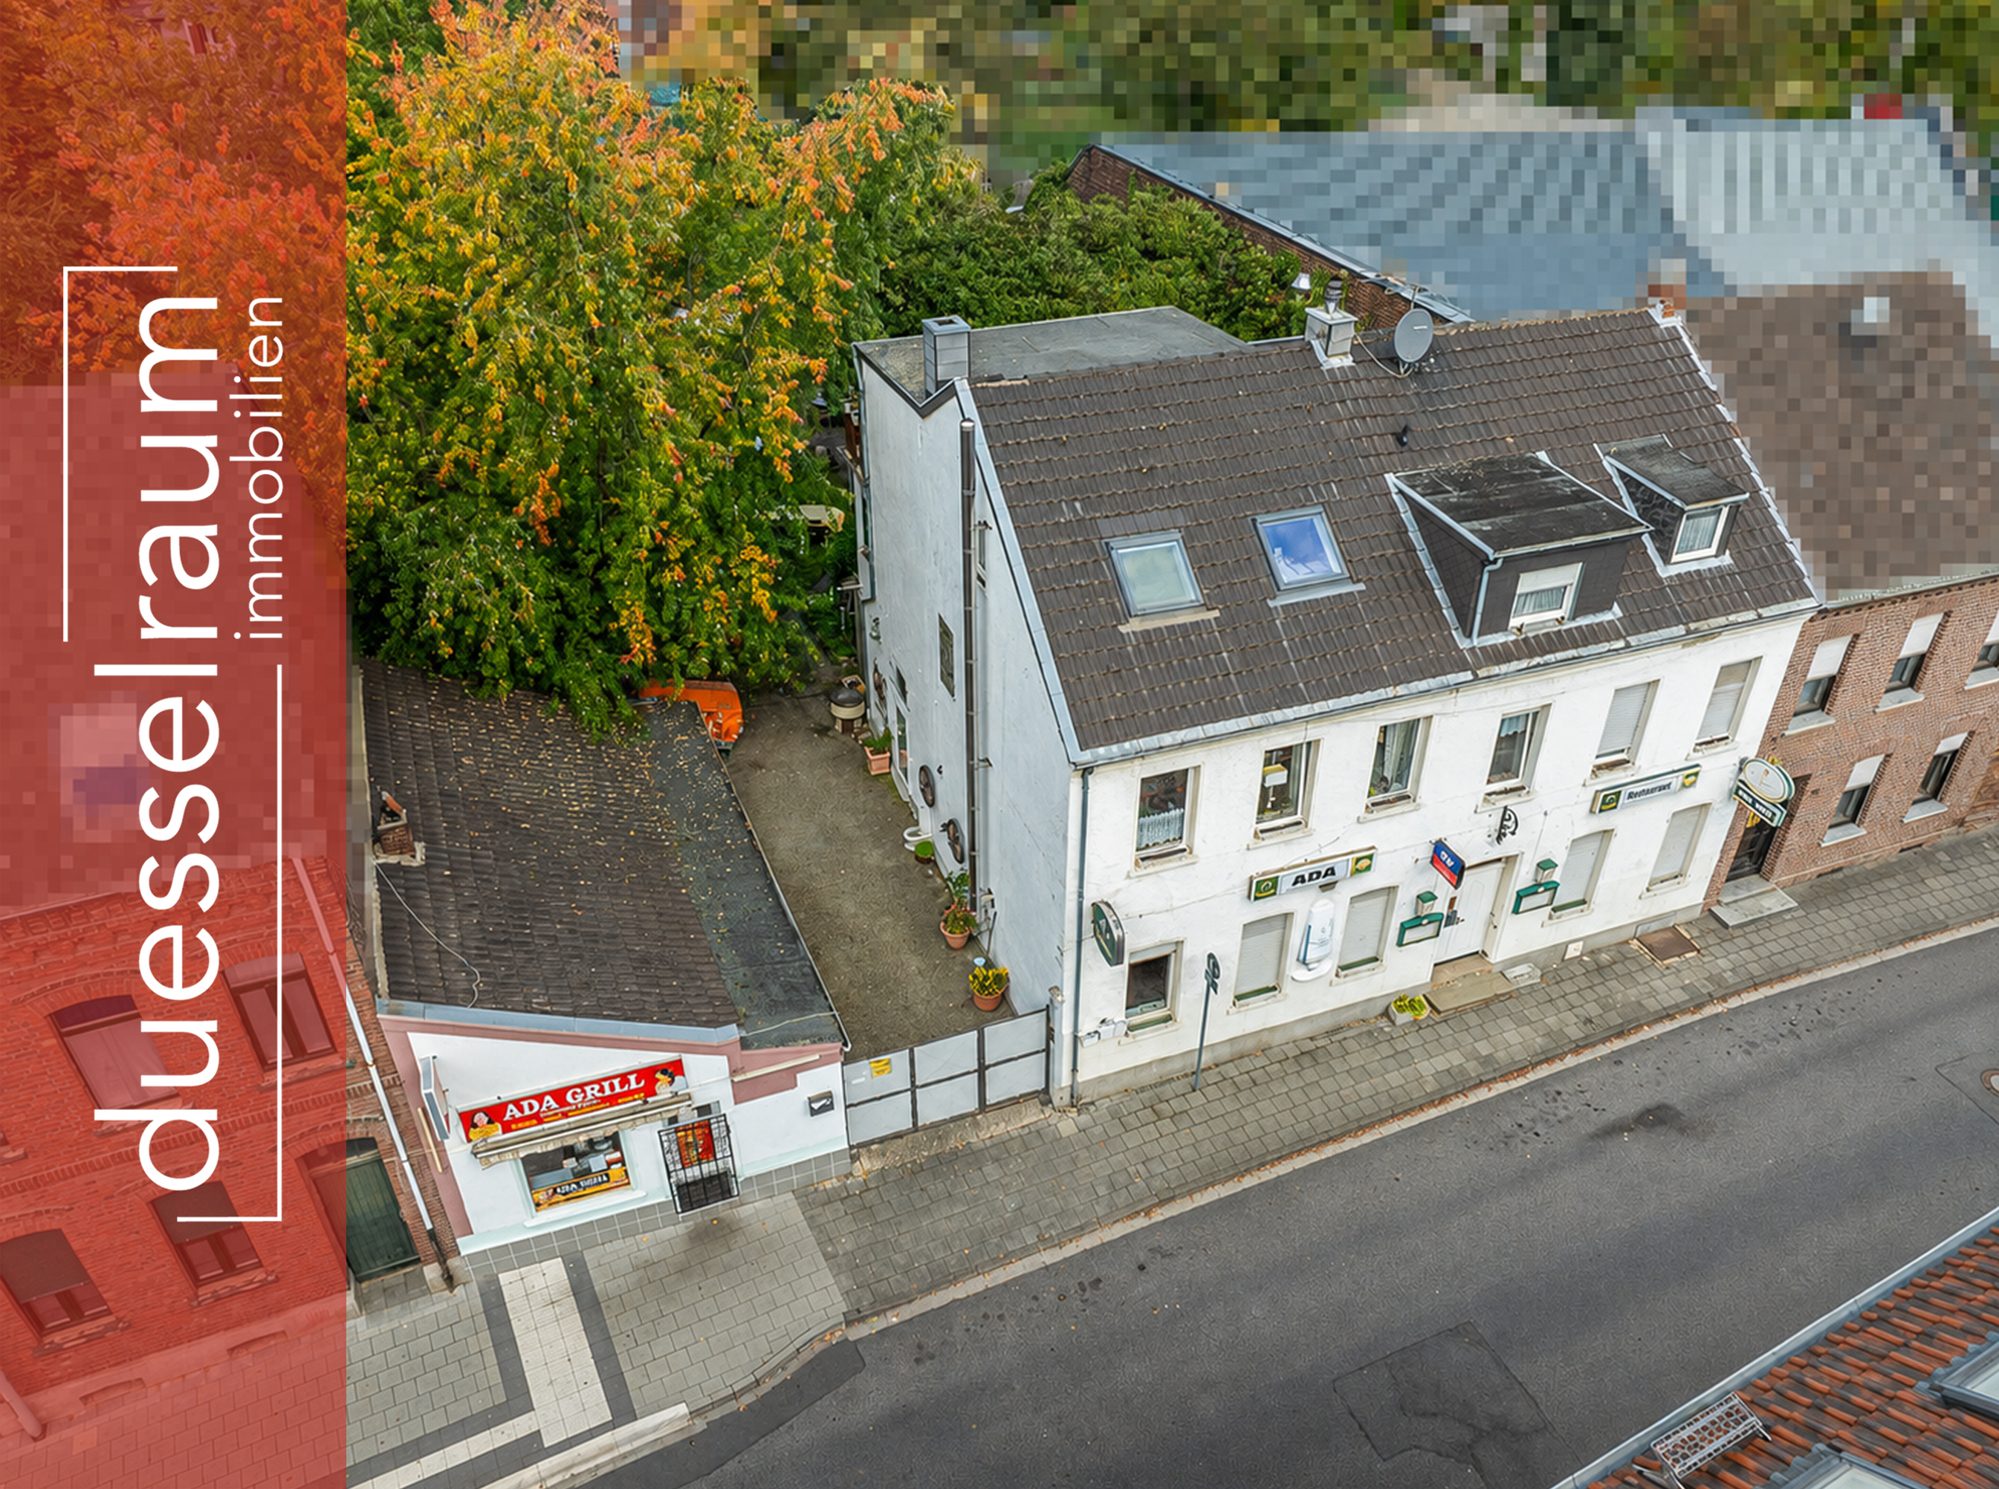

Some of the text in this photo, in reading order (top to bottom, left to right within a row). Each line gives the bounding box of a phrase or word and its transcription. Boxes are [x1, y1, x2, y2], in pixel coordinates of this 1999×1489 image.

[1627, 782, 1672, 800] Restaurant
[1292, 867, 1336, 886] ADA
[504, 1096, 559, 1120] ADA
[565, 1074, 645, 1104] GRILL
